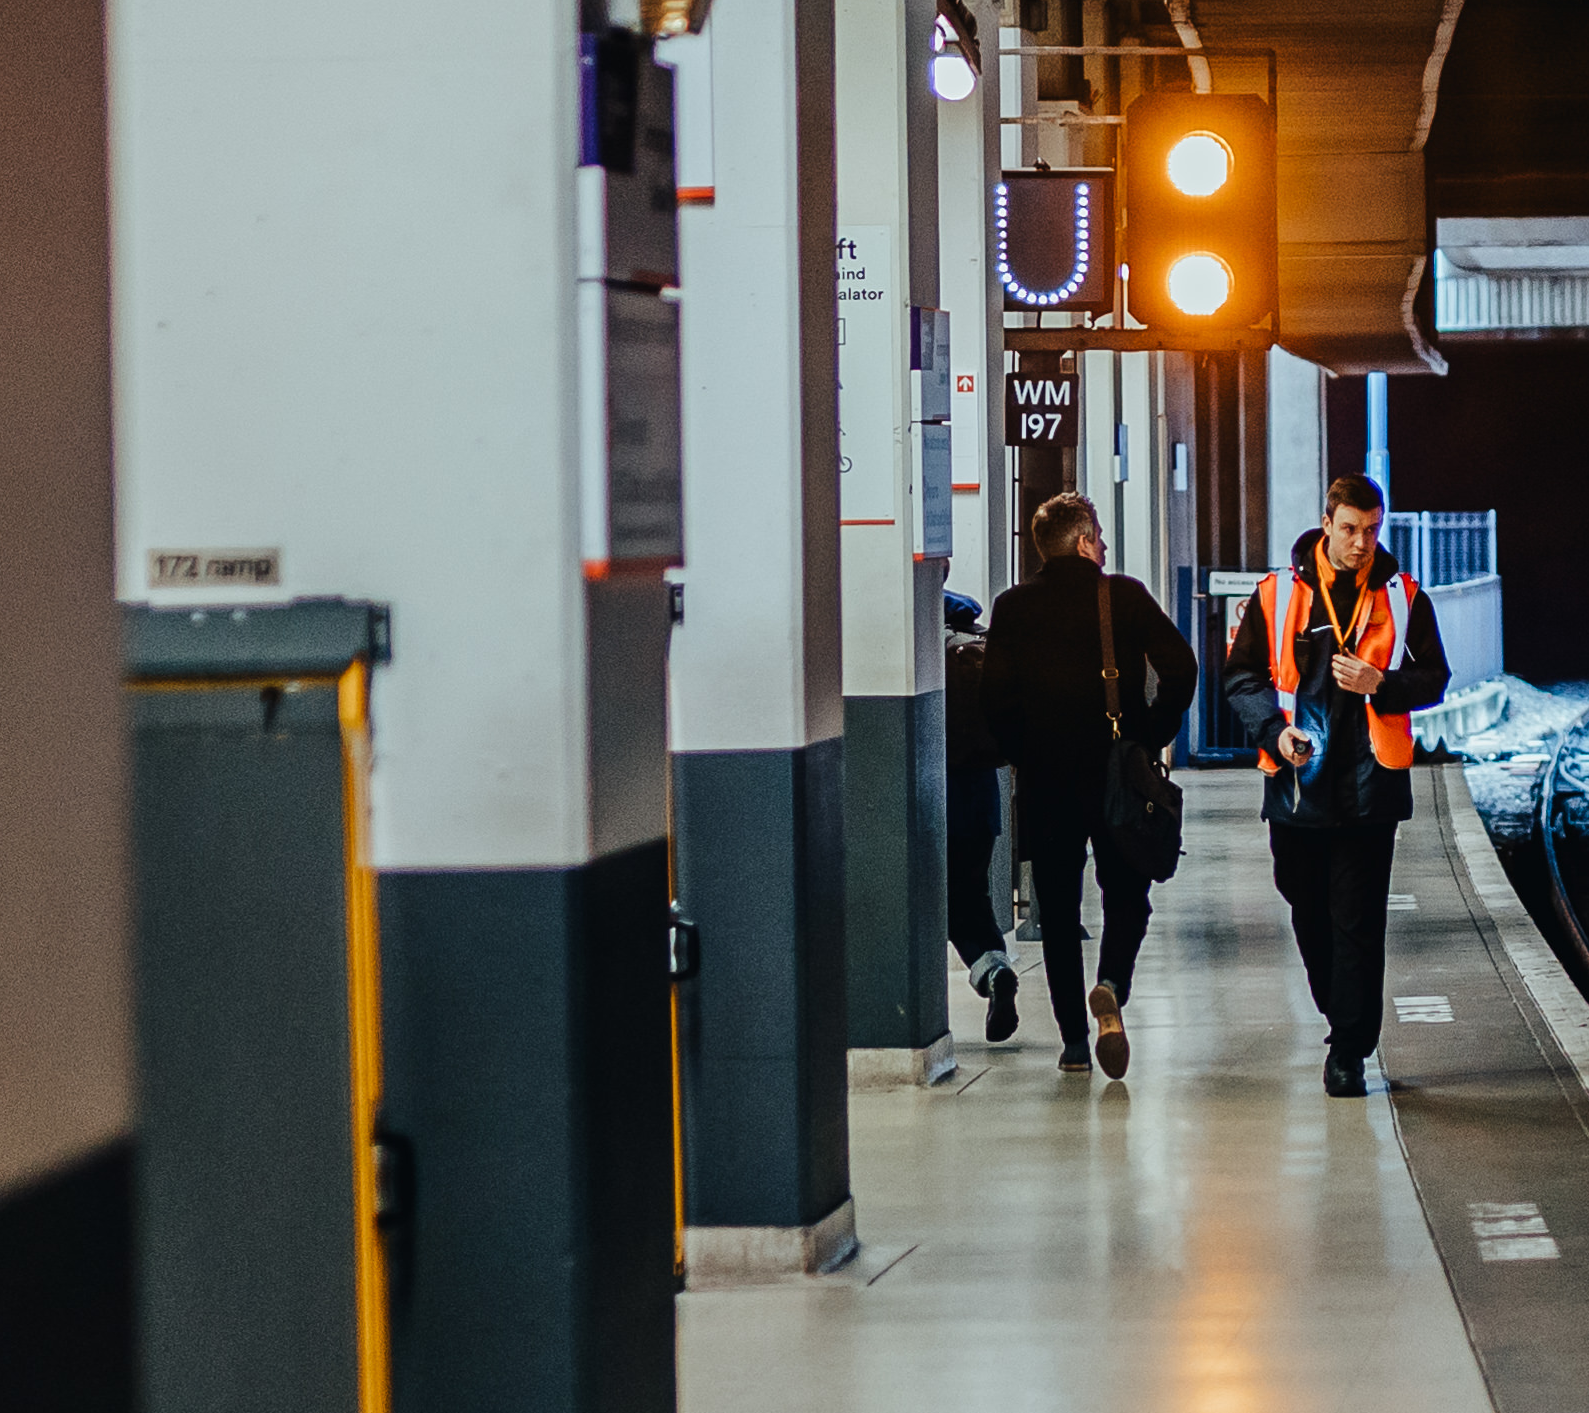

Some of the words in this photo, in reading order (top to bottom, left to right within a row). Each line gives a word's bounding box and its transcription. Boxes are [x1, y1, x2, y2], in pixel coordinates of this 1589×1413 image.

[835, 237, 857, 259] ft
[838, 288, 884, 300] alator
[1013, 380, 1071, 406] WM
[1021, 413, 1062, 440] 197
[156, 554, 199, 578] 172
[206, 559, 271, 582] ramp
